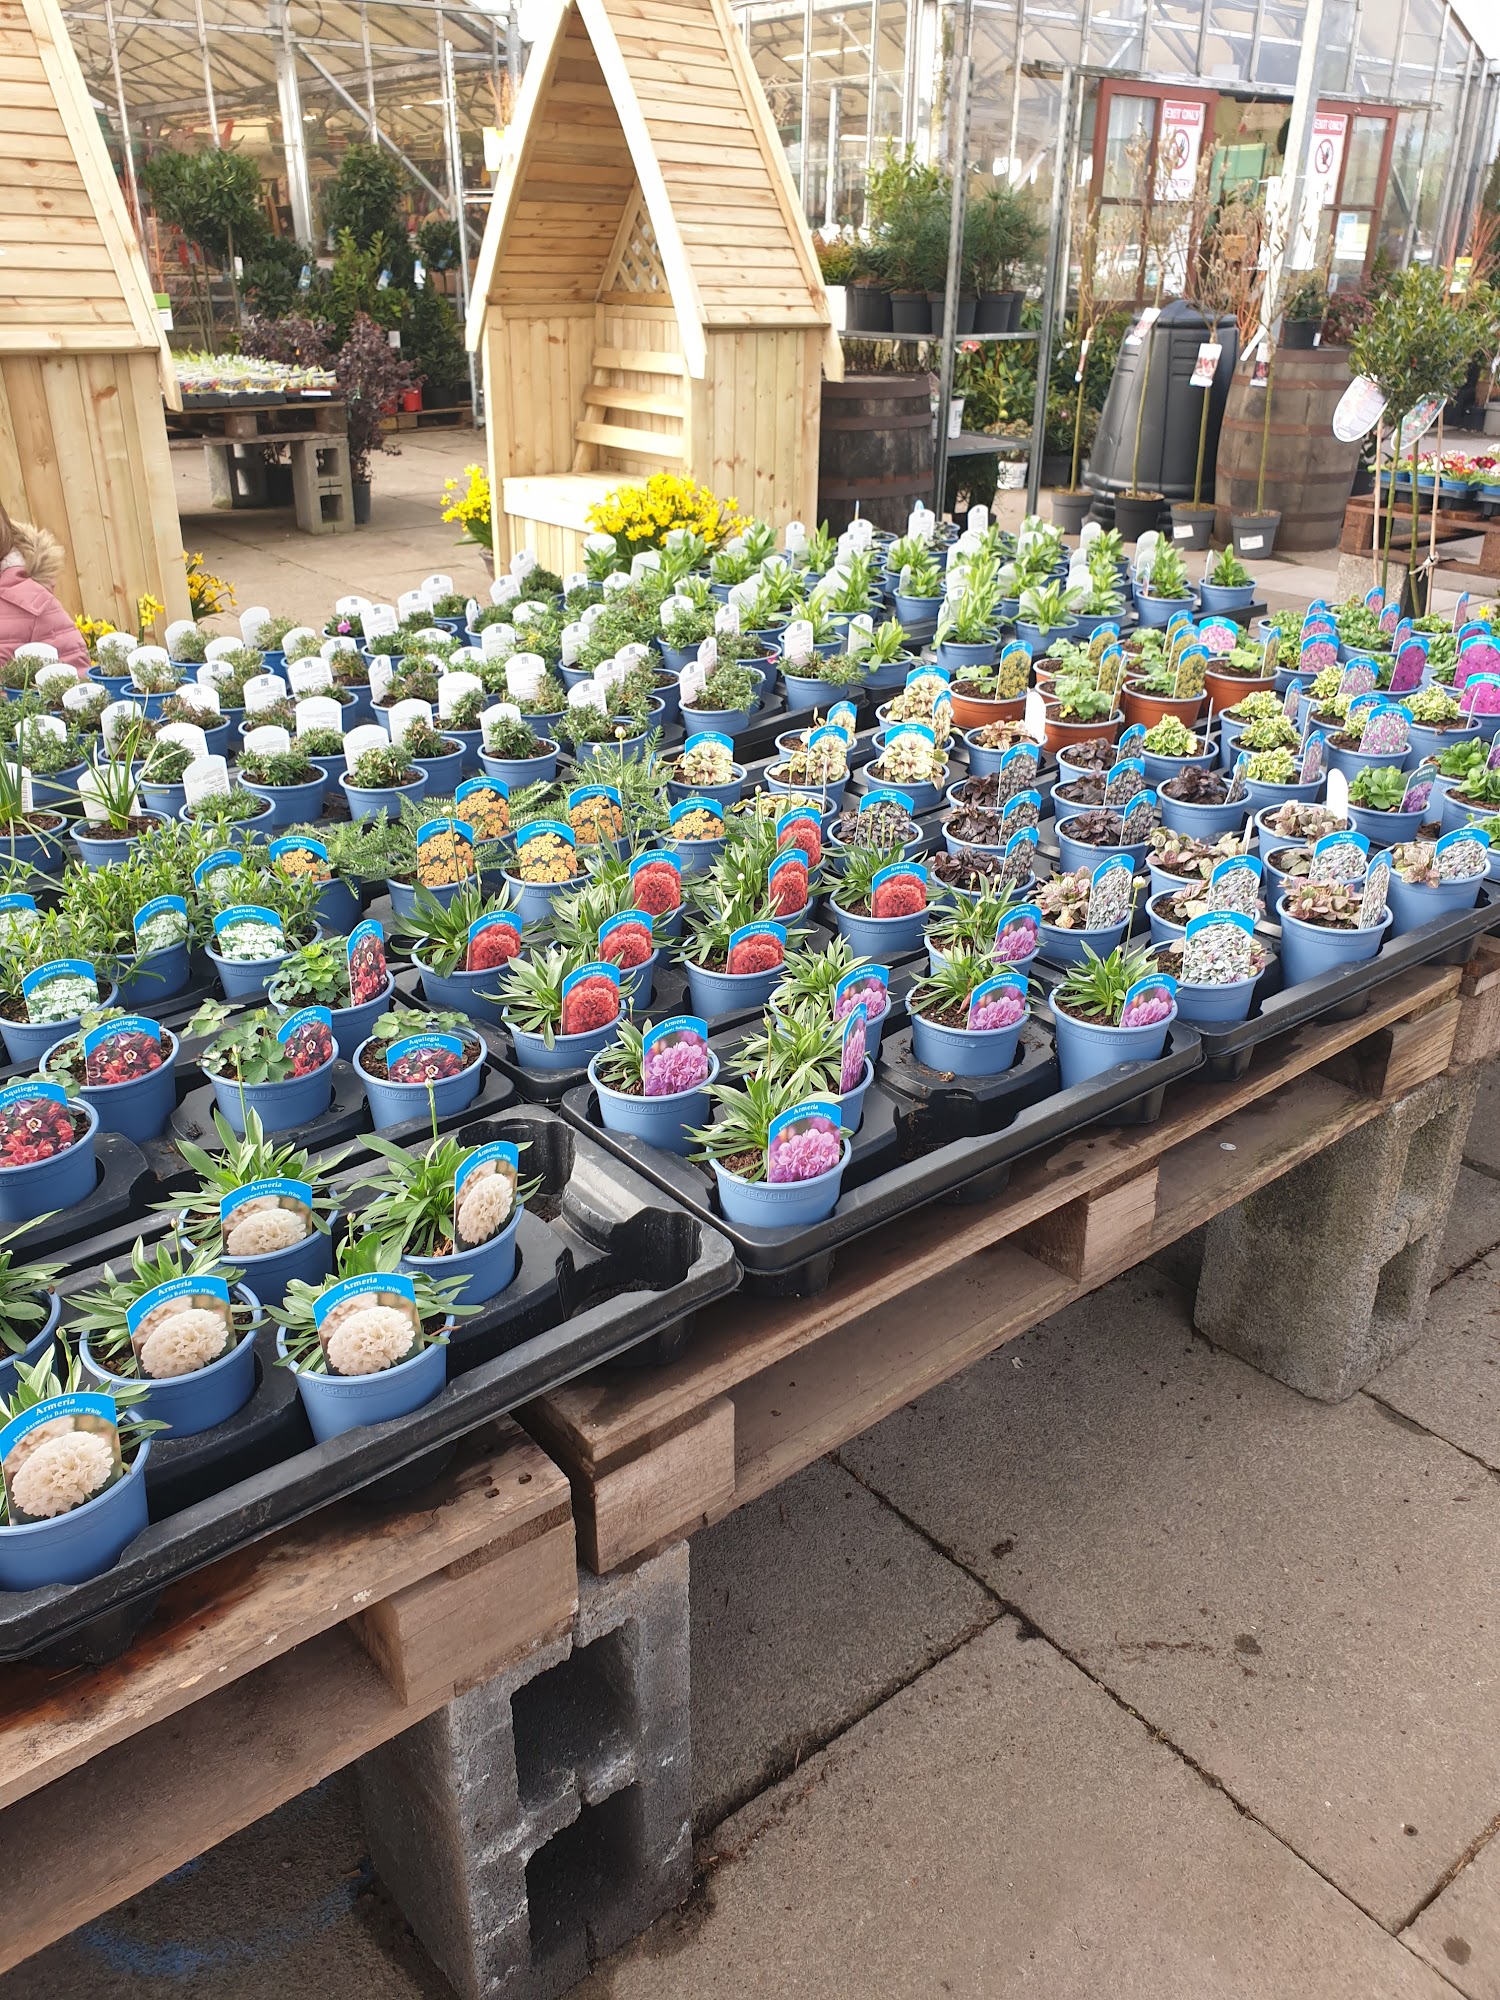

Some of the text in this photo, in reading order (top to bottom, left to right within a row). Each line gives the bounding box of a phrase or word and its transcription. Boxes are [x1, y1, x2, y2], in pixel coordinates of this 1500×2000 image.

[106, 1019, 138, 1031] Aquilegia
[664, 1018, 687, 1028] Armeria
[409, 1035, 440, 1046] Aquilegia
[3, 1085, 38, 1099] Aquilegia
[793, 1103, 819, 1115] Armeria
[477, 1144, 500, 1159] Armeria
[250, 1182, 282, 1192] Armeria
[158, 1279, 193, 1297] Armeria
[343, 1276, 378, 1291] Armeria
[359, 1285, 385, 1293] Ballerina
[386, 1286, 402, 1294] White
[173, 1288, 200, 1297] Ballerina
[200, 1287, 217, 1296] White
[36, 1398, 76, 1416] Armeria
[53, 1407, 84, 1417] Ballerina
[85, 1407, 102, 1416] White
